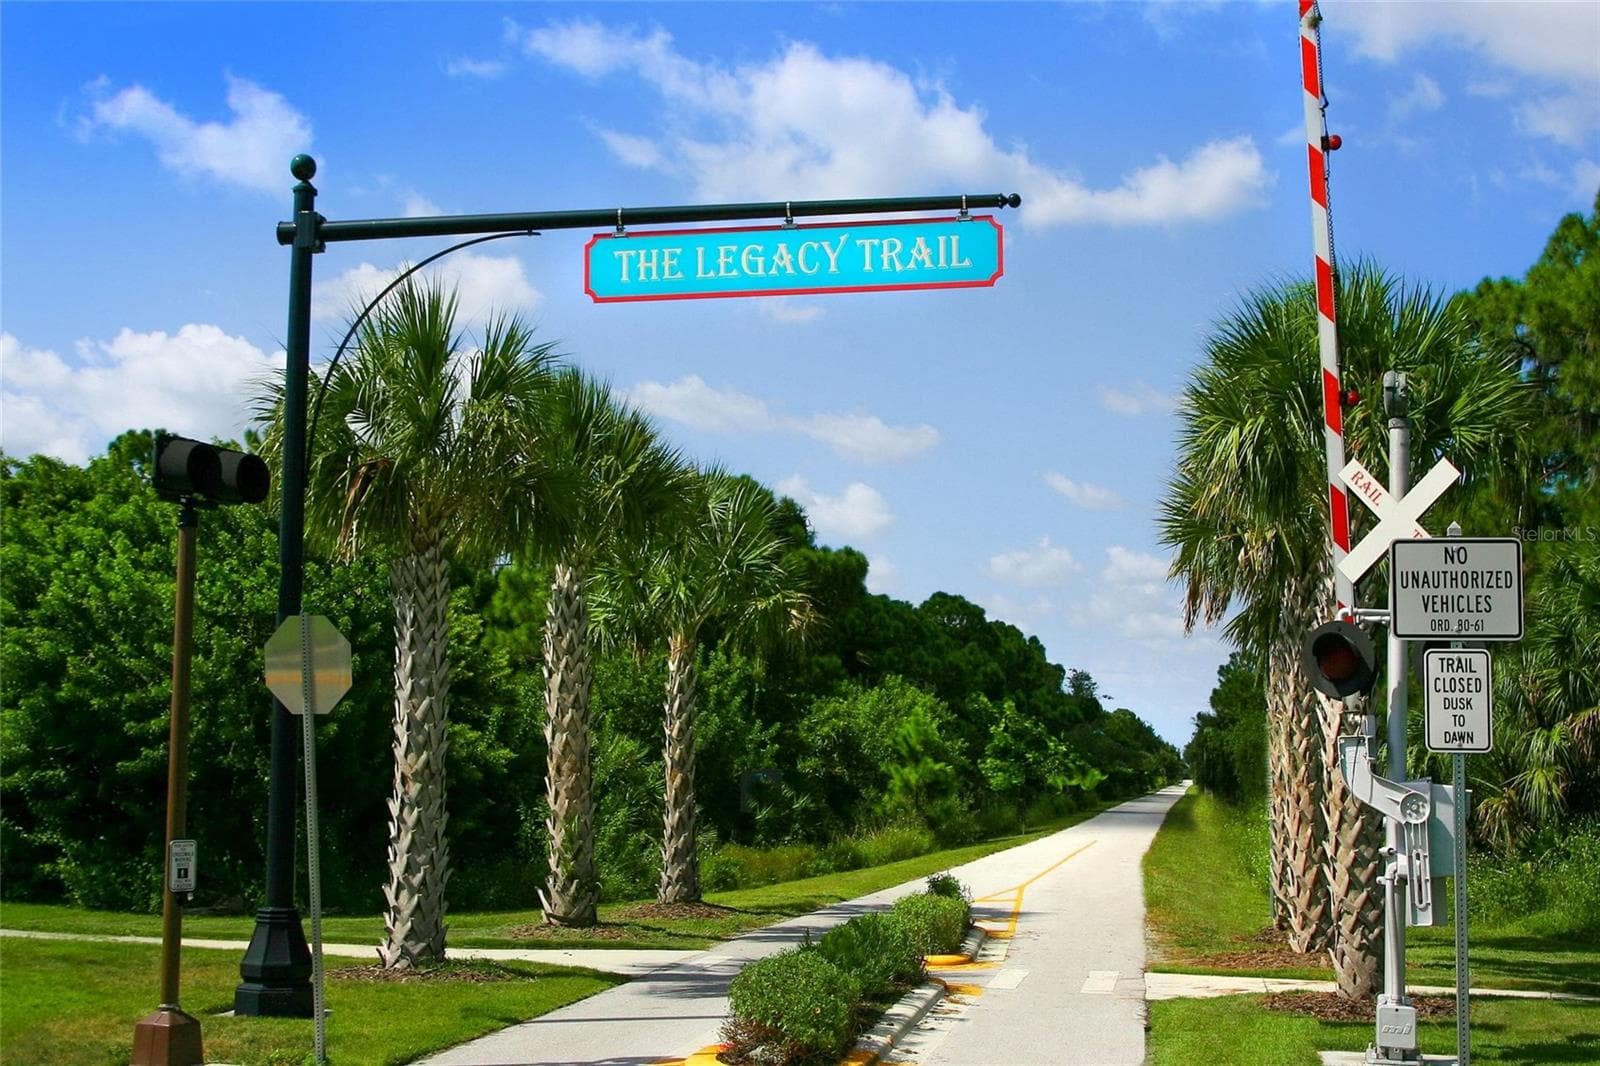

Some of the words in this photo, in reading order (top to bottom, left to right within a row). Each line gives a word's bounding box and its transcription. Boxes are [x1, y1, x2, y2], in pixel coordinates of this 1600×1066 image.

[614, 246, 685, 283] THE
[695, 233, 849, 280] LEGACY
[855, 234, 972, 273] TRAIL
[1350, 470, 1383, 507] RAIL
[1444, 546, 1468, 565] NO
[1400, 570, 1513, 589] UNAUTHORIZED
[1422, 594, 1492, 613] VEHICLES
[1430, 619, 1454, 632] ORD.
[1457, 619, 1484, 632] 80-61
[1438, 657, 1477, 673] TRAIL
[1434, 677, 1482, 693] CLOSED
[1443, 697, 1473, 710] DUSK
[1452, 714, 1466, 727] TO
[1444, 731, 1474, 744] DAWN
